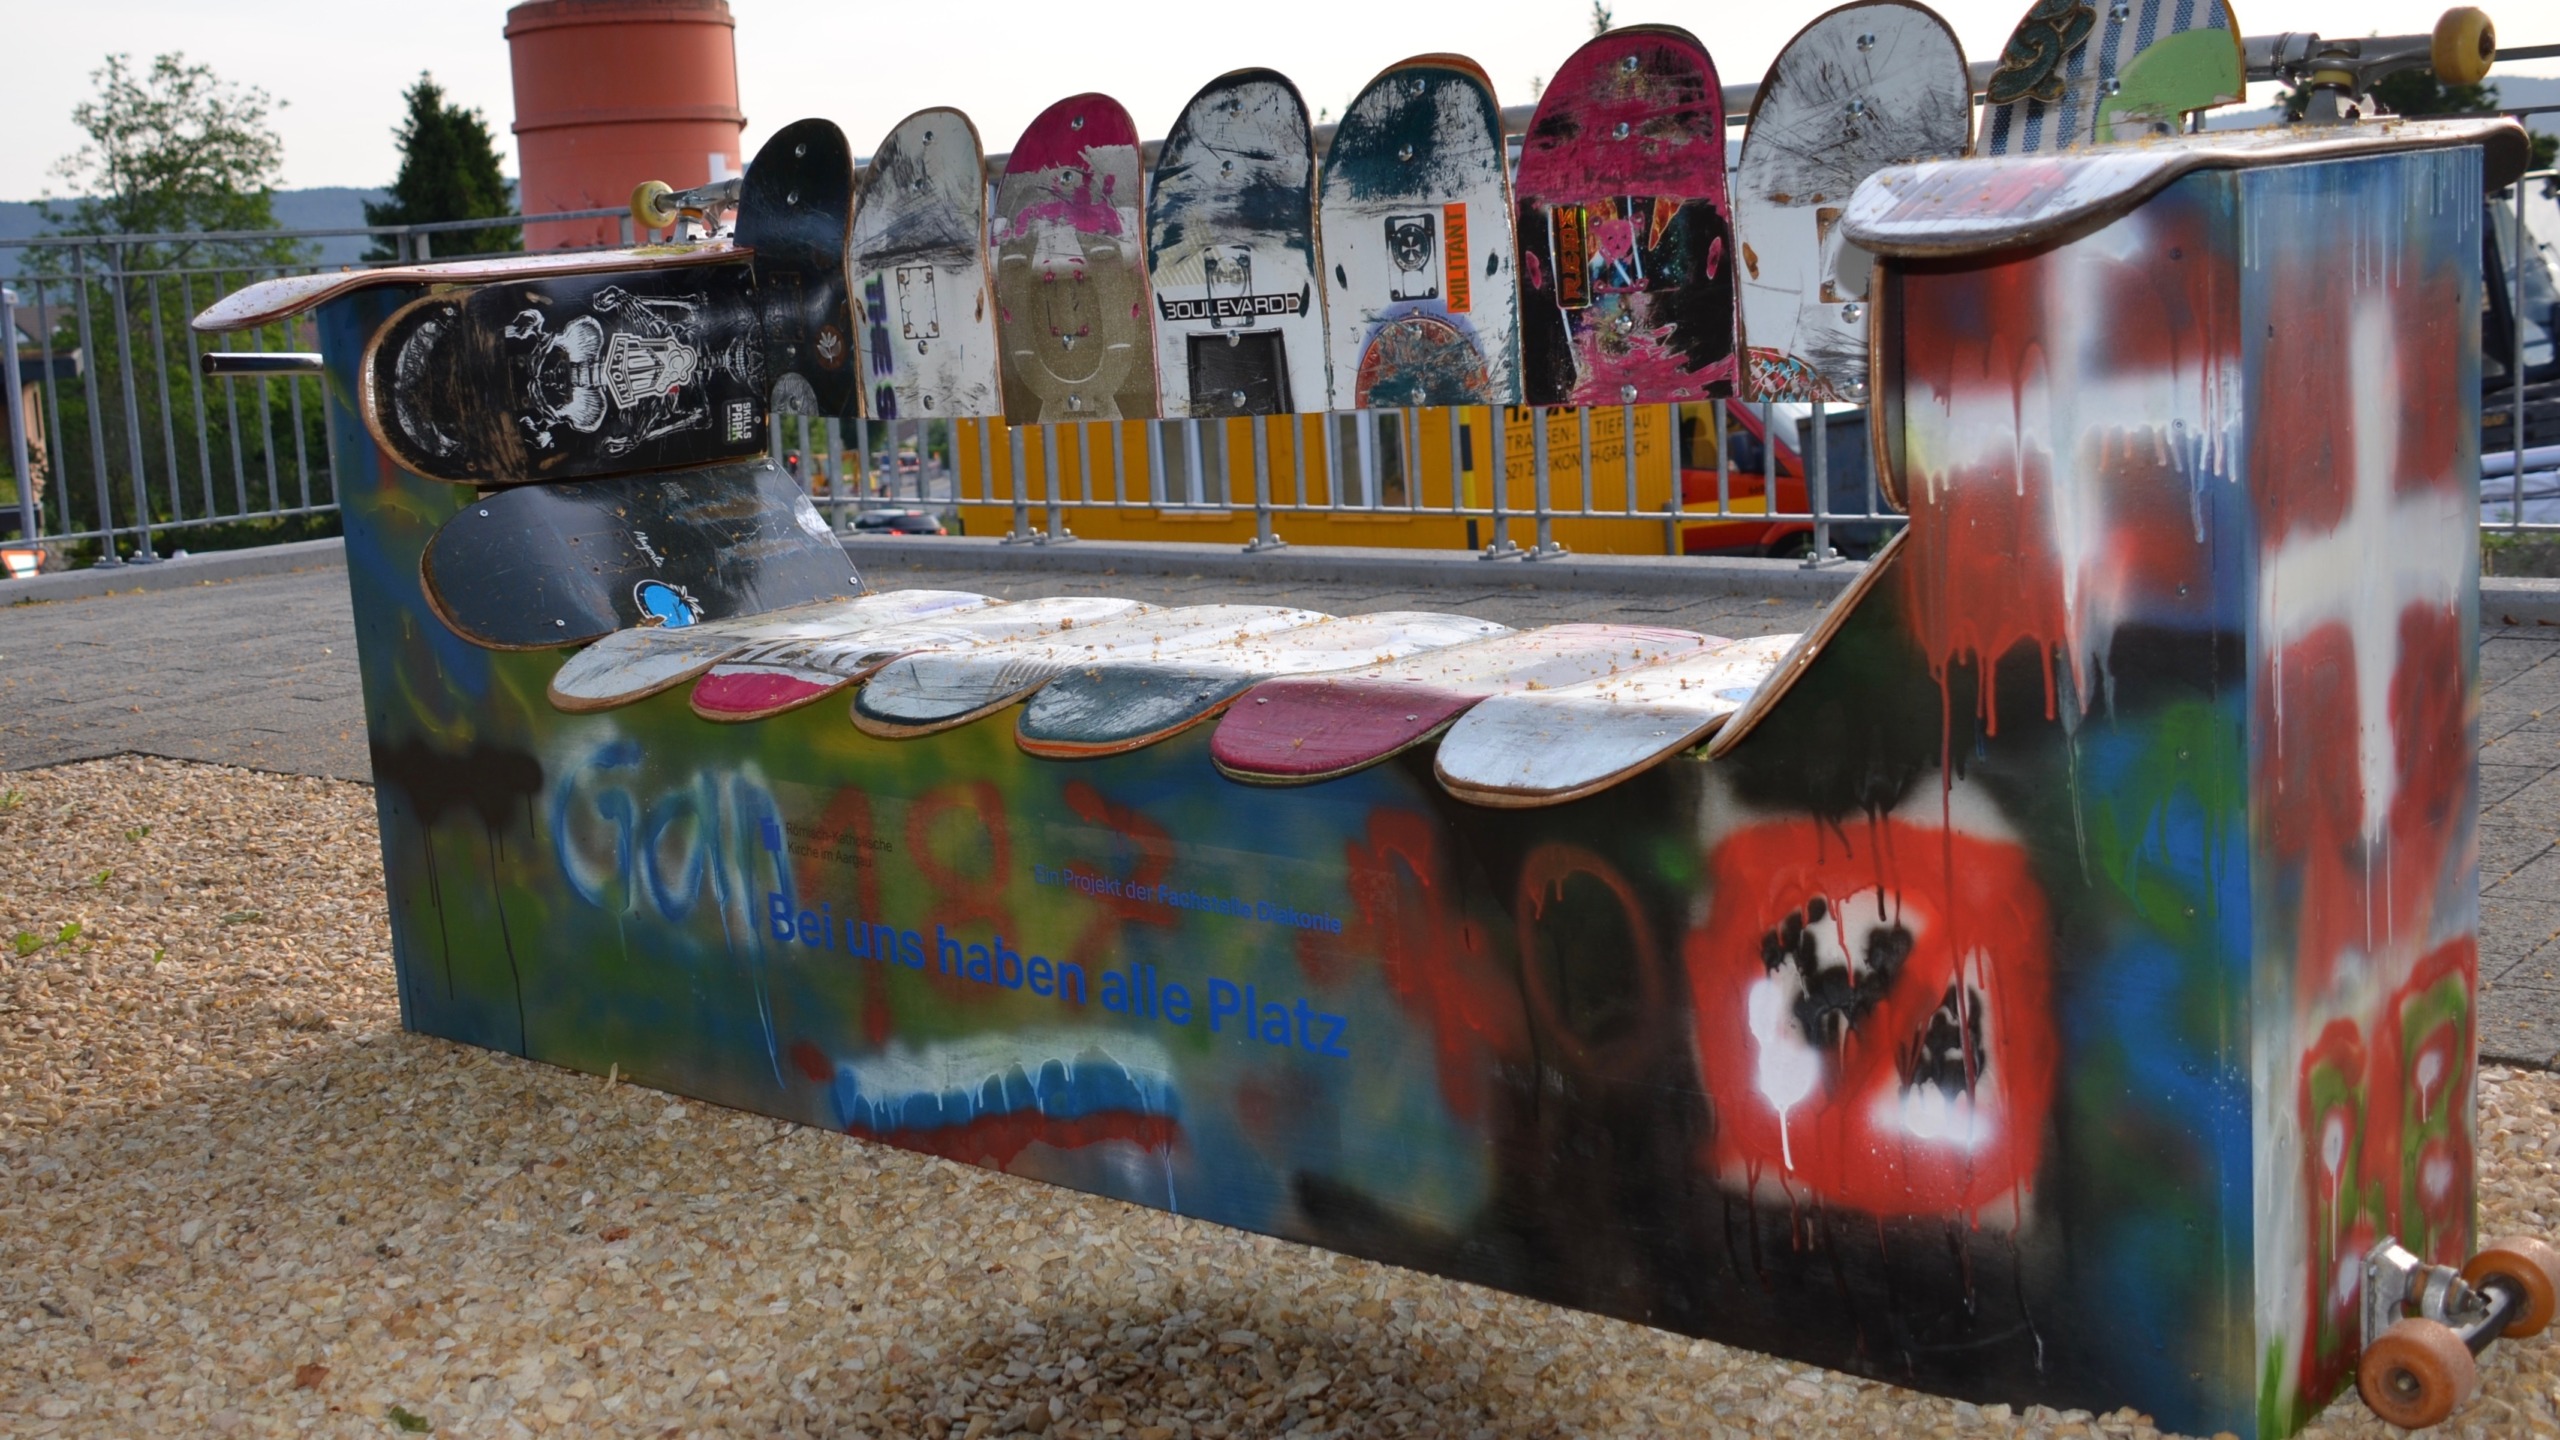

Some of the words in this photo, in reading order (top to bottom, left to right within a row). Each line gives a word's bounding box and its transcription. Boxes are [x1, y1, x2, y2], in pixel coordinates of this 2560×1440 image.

[1445, 211, 1469, 310] MILITANT
[611, 339, 632, 400] FACTORY
[731, 403, 743, 441] PARK
[742, 401, 752, 439] SKILLS
[1595, 410, 1651, 436] TIEFAU
[786, 822, 893, 853] Römisch-Katholische
[787, 841, 819, 860] Kirche
[820, 847, 834, 861] im
[835, 850, 873, 869] Aargau
[1034, 863, 1060, 886] Ein
[1062, 868, 1122, 897] Projekt
[1125, 880, 1154, 901] der
[1157, 884, 1253, 920] Fachstelle
[1256, 899, 1343, 935] Diakonie
[768, 891, 835, 950] Bei
[845, 917, 926, 970] uns
[935, 923, 1087, 1006] haben
[1100, 960, 1193, 1027] alle
[1207, 976, 1350, 1060] Platz
